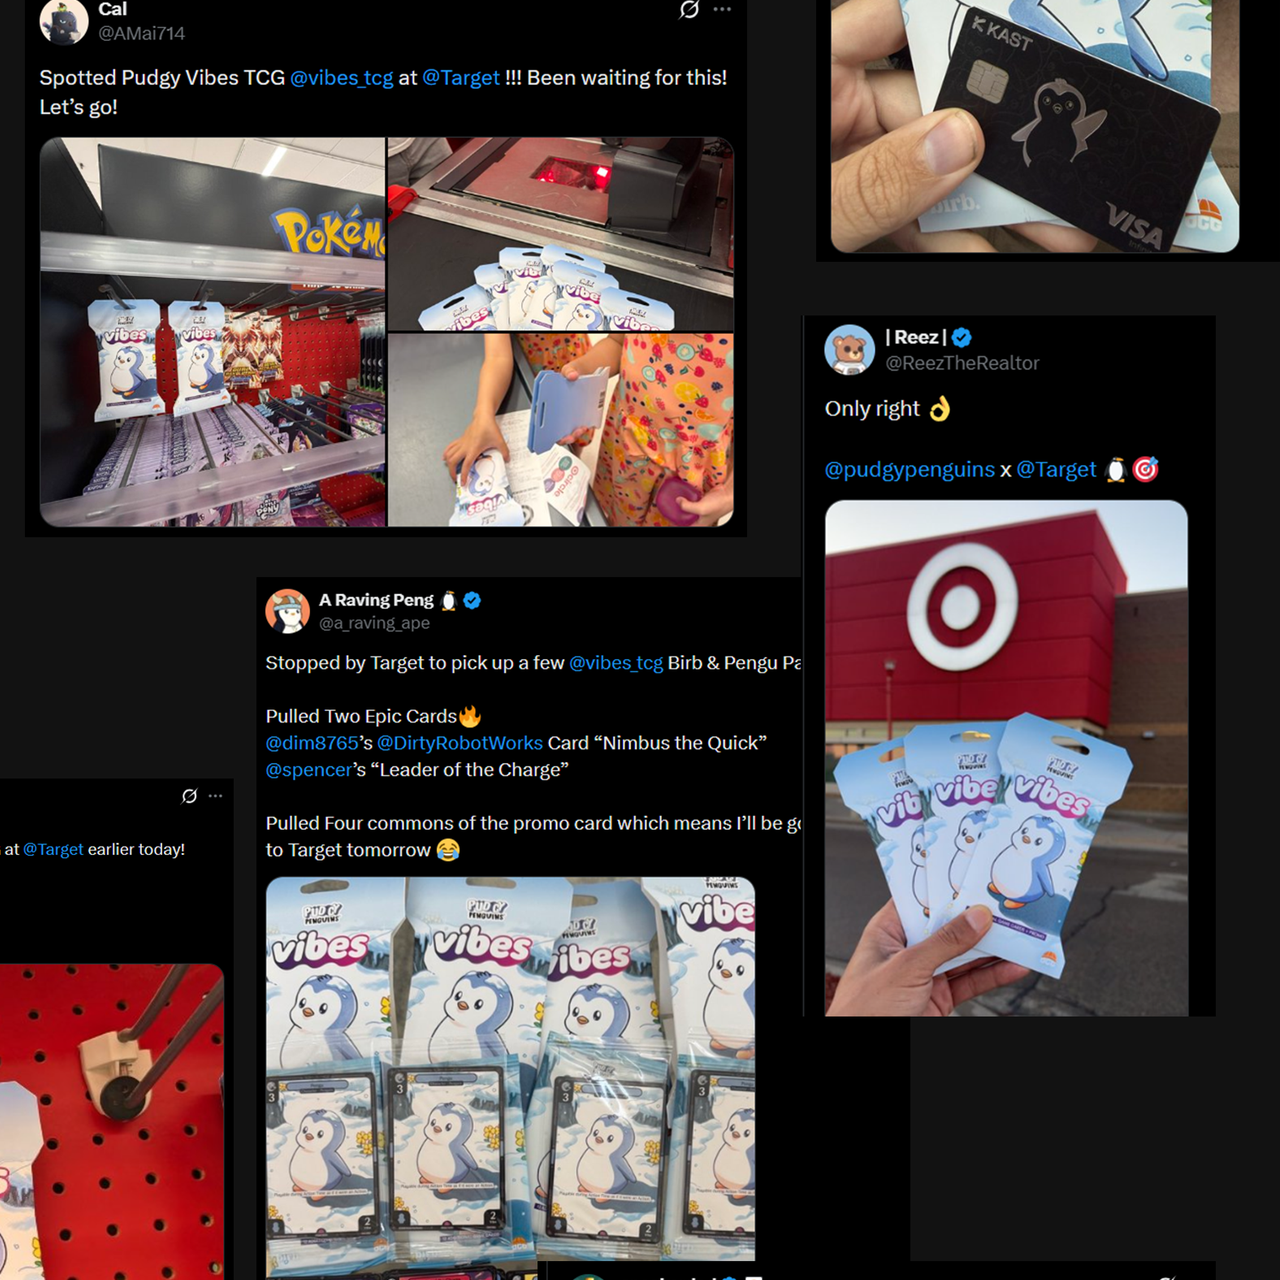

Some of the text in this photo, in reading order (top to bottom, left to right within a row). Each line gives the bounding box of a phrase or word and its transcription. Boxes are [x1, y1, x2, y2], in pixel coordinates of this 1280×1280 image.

[98, 25, 186, 42] @AMai714
[88, 98, 118, 119] go!
[1106, 201, 1164, 250] VISA
[824, 399, 921, 422] Only right
[1014, 775, 1090, 818] vibes
